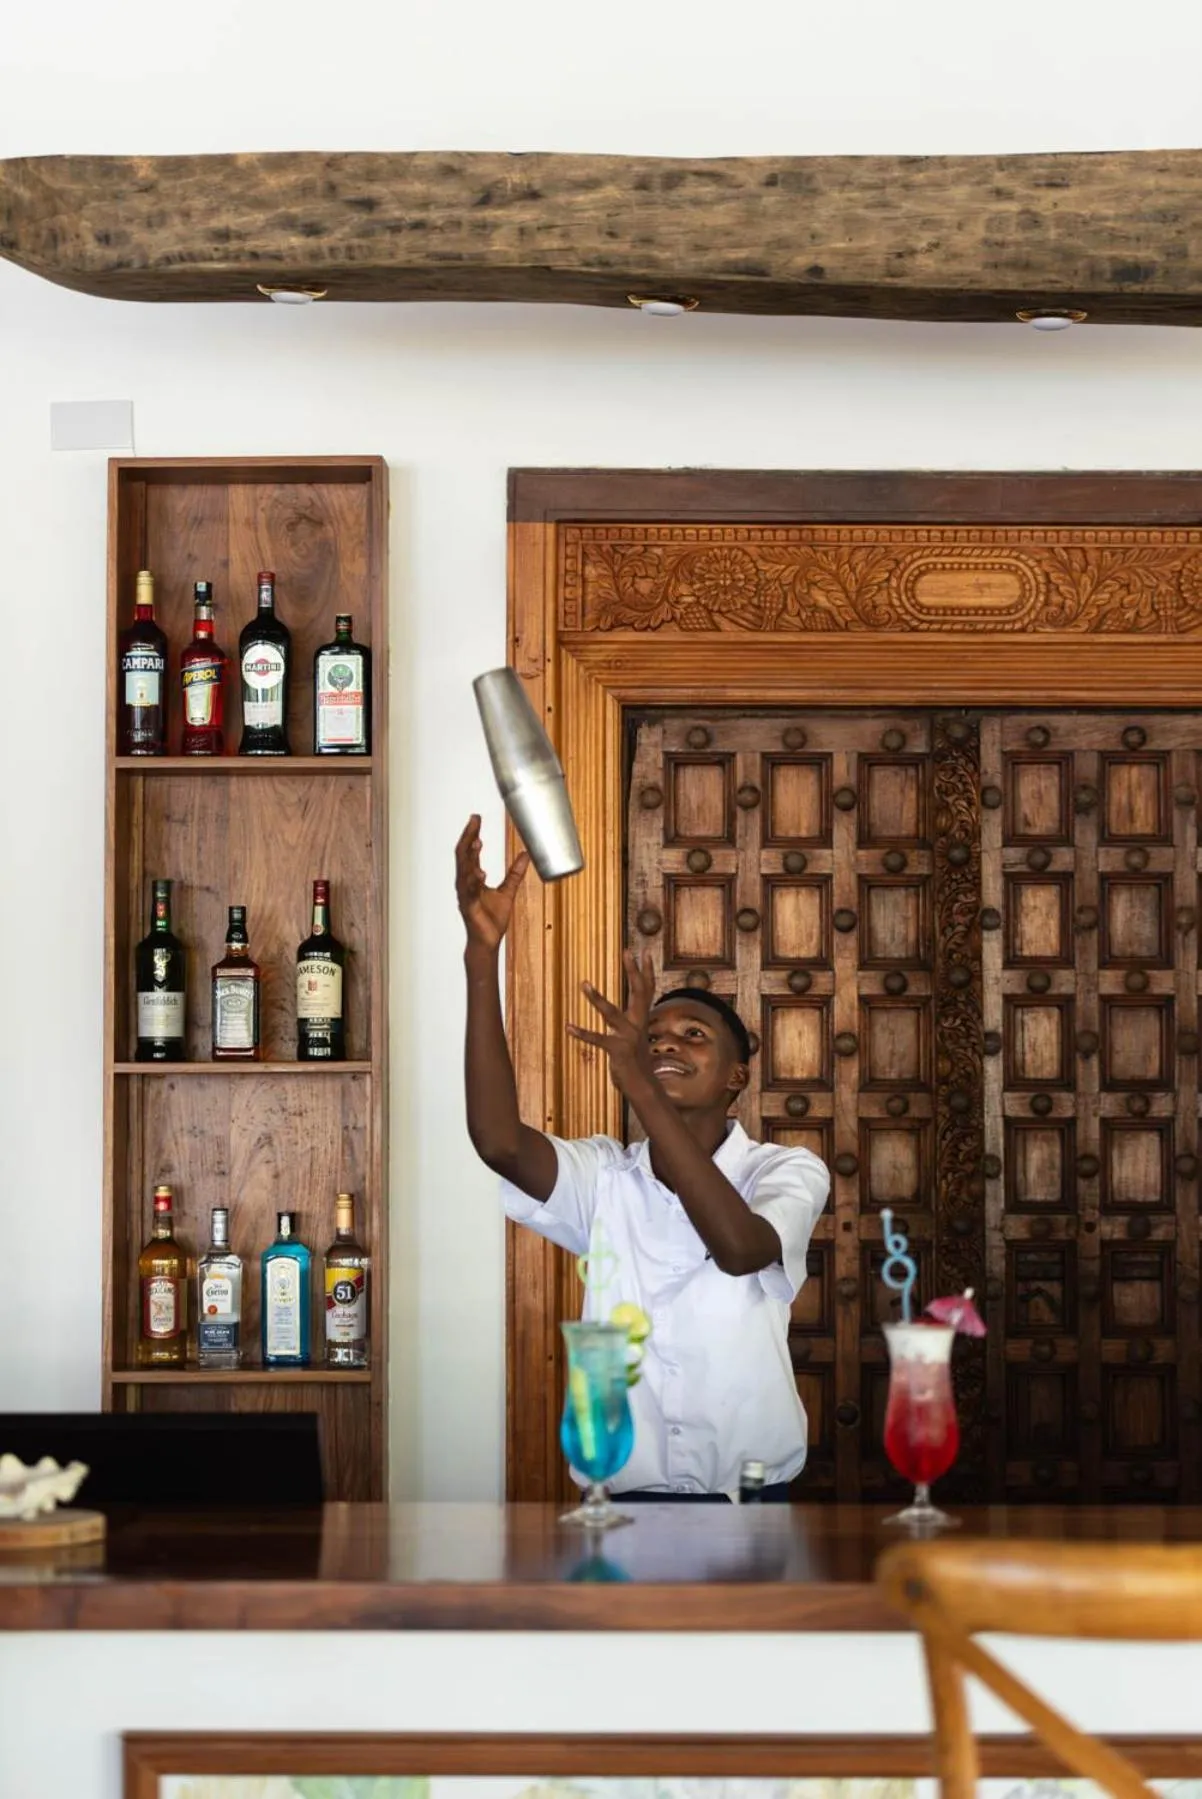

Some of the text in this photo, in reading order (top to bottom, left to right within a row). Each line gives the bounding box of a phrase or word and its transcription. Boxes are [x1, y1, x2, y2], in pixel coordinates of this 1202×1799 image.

[122, 657, 164, 670] CAMPARI
[245, 663, 281, 672] MARTINI
[183, 668, 217, 686] APEROL
[297, 964, 337, 976] AMESON
[336, 1284, 352, 1300] 51
